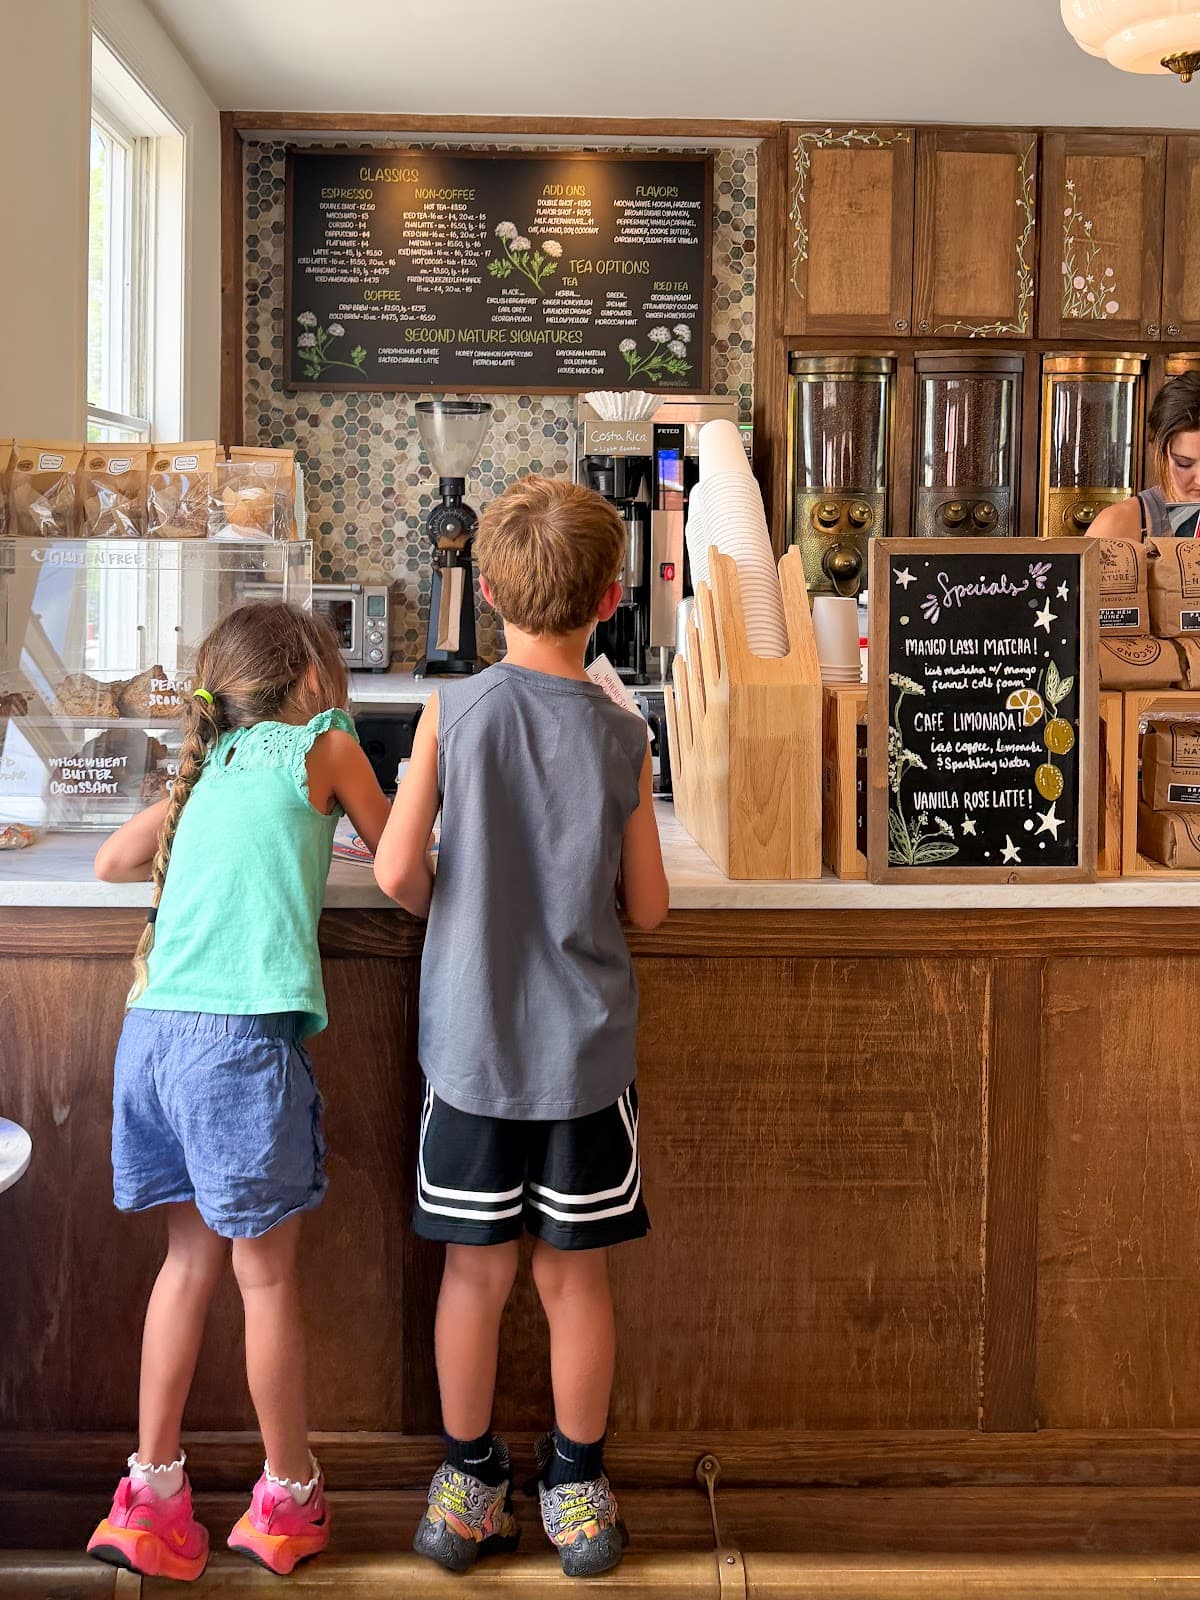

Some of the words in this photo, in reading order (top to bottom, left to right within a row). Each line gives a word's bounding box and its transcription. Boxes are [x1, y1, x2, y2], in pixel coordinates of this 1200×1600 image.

[360, 167, 419, 183] CLASSICS
[321, 187, 373, 200] ESPRESSO
[415, 188, 476, 201] NON-COFFEE
[543, 185, 564, 196] ADD
[566, 186, 587, 196] ONS
[636, 186, 680, 198] FLAVORS
[436, 203, 447, 211] TEA
[568, 259, 593, 275] TEA
[596, 259, 651, 276] OPTIONS
[561, 276, 579, 287] TEA
[653, 280, 672, 292] ICED
[672, 280, 690, 291] TEA
[363, 289, 401, 302] COFFEE
[404, 326, 455, 344] SECOND
[457, 328, 506, 345] NATURE
[509, 329, 584, 345] SIGNATURES
[590, 429, 625, 443] Costa
[626, 430, 648, 443] Rica
[937, 571, 1029, 608] Specials
[904, 638, 947, 657] MANGO
[950, 638, 980, 656] LASSI
[984, 638, 1038, 656] MATCHA!
[1116, 643, 1155, 660] SECOND
[943, 663, 987, 677] matcha
[1003, 664, 1037, 681] mango
[932, 677, 969, 694] fennel
[913, 711, 945, 733] CAFE
[952, 710, 1023, 733] LIMONADA!
[62, 767, 114, 781] BUTTER
[50, 780, 119, 795] CROISSANT
[913, 791, 960, 811] VANILLA
[963, 790, 991, 812] ROSE
[992, 788, 1033, 810] LATTE!
